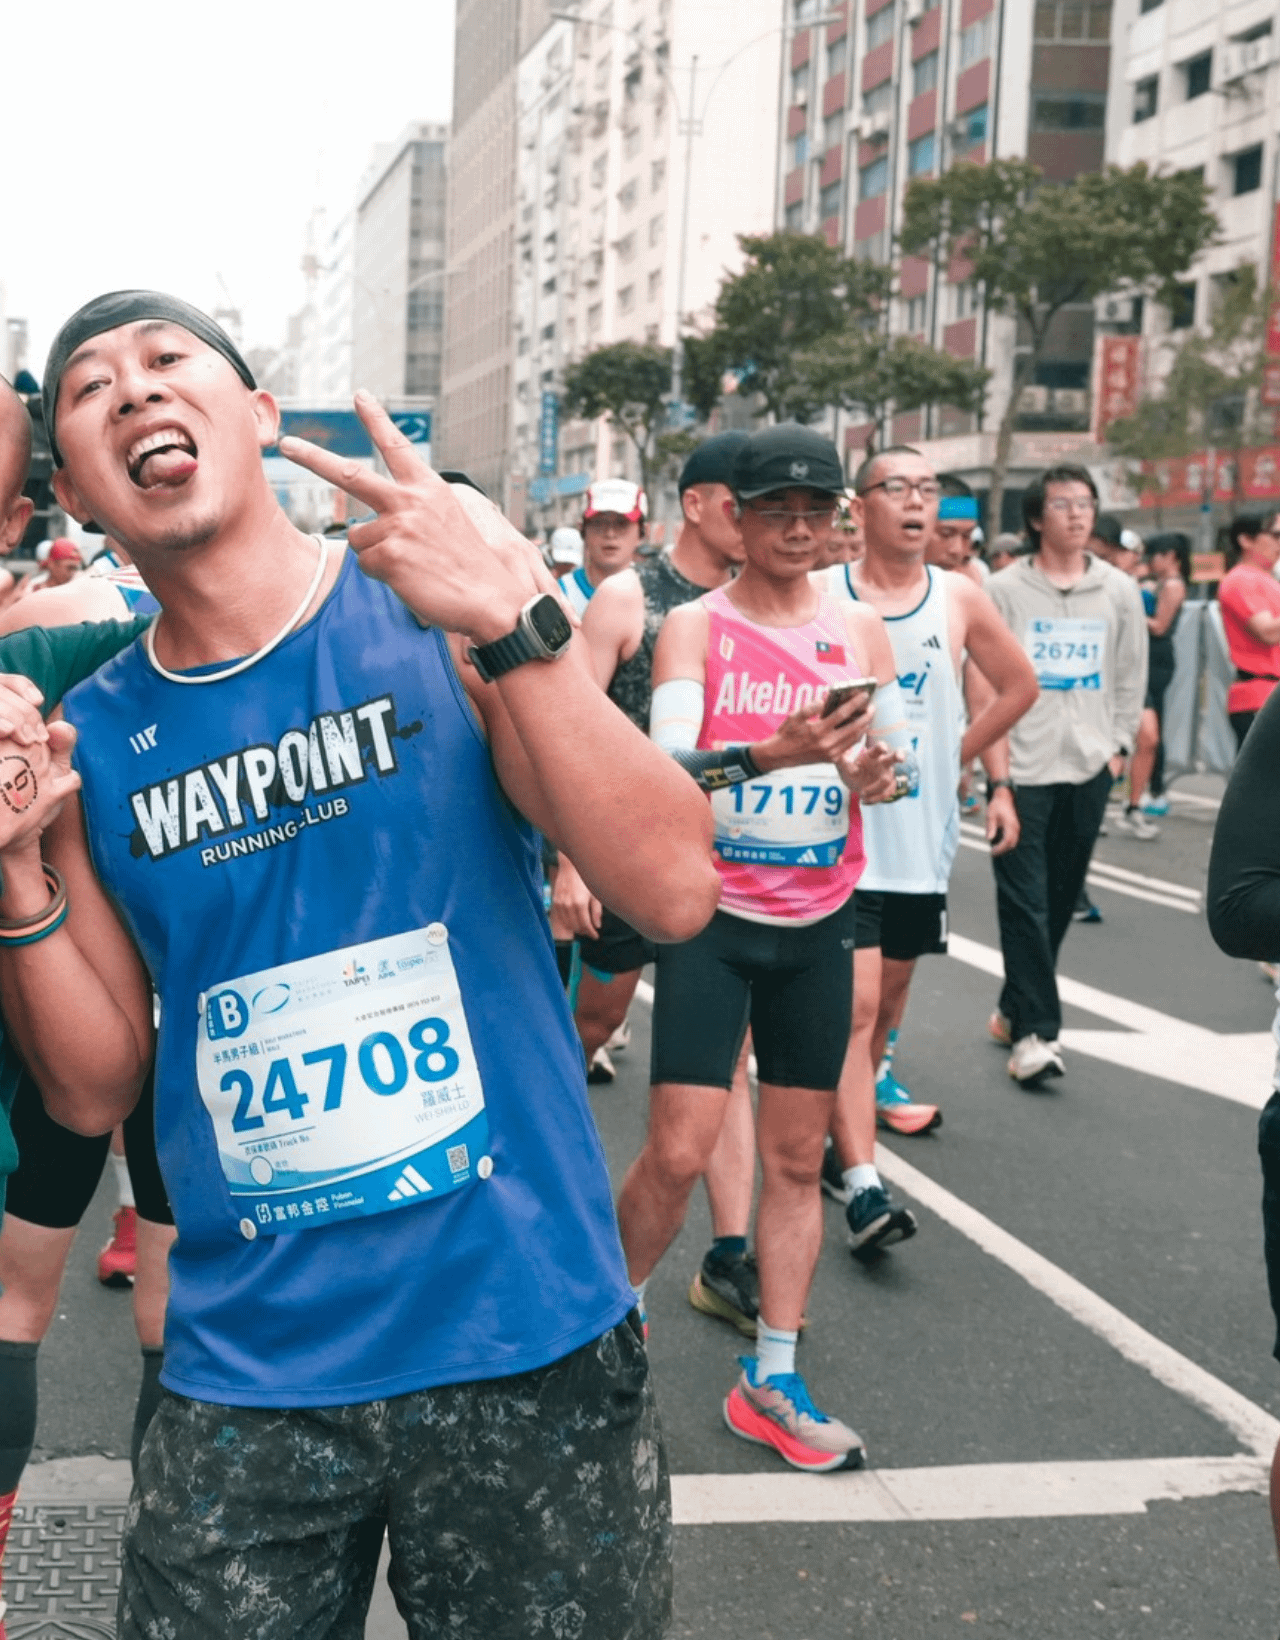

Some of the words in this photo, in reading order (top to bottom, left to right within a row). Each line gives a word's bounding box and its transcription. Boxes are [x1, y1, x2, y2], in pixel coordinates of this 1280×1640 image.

[1033, 642, 1099, 660] 26741
[131, 697, 395, 857] WAYPOINT
[729, 782, 843, 816] 17179
[200, 820, 298, 867] RUNNING
[298, 797, 349, 829] LUB
[218, 993, 242, 1031] B
[214, 1042, 260, 1064] 半馬男子組
[220, 1016, 460, 1133] 24708
